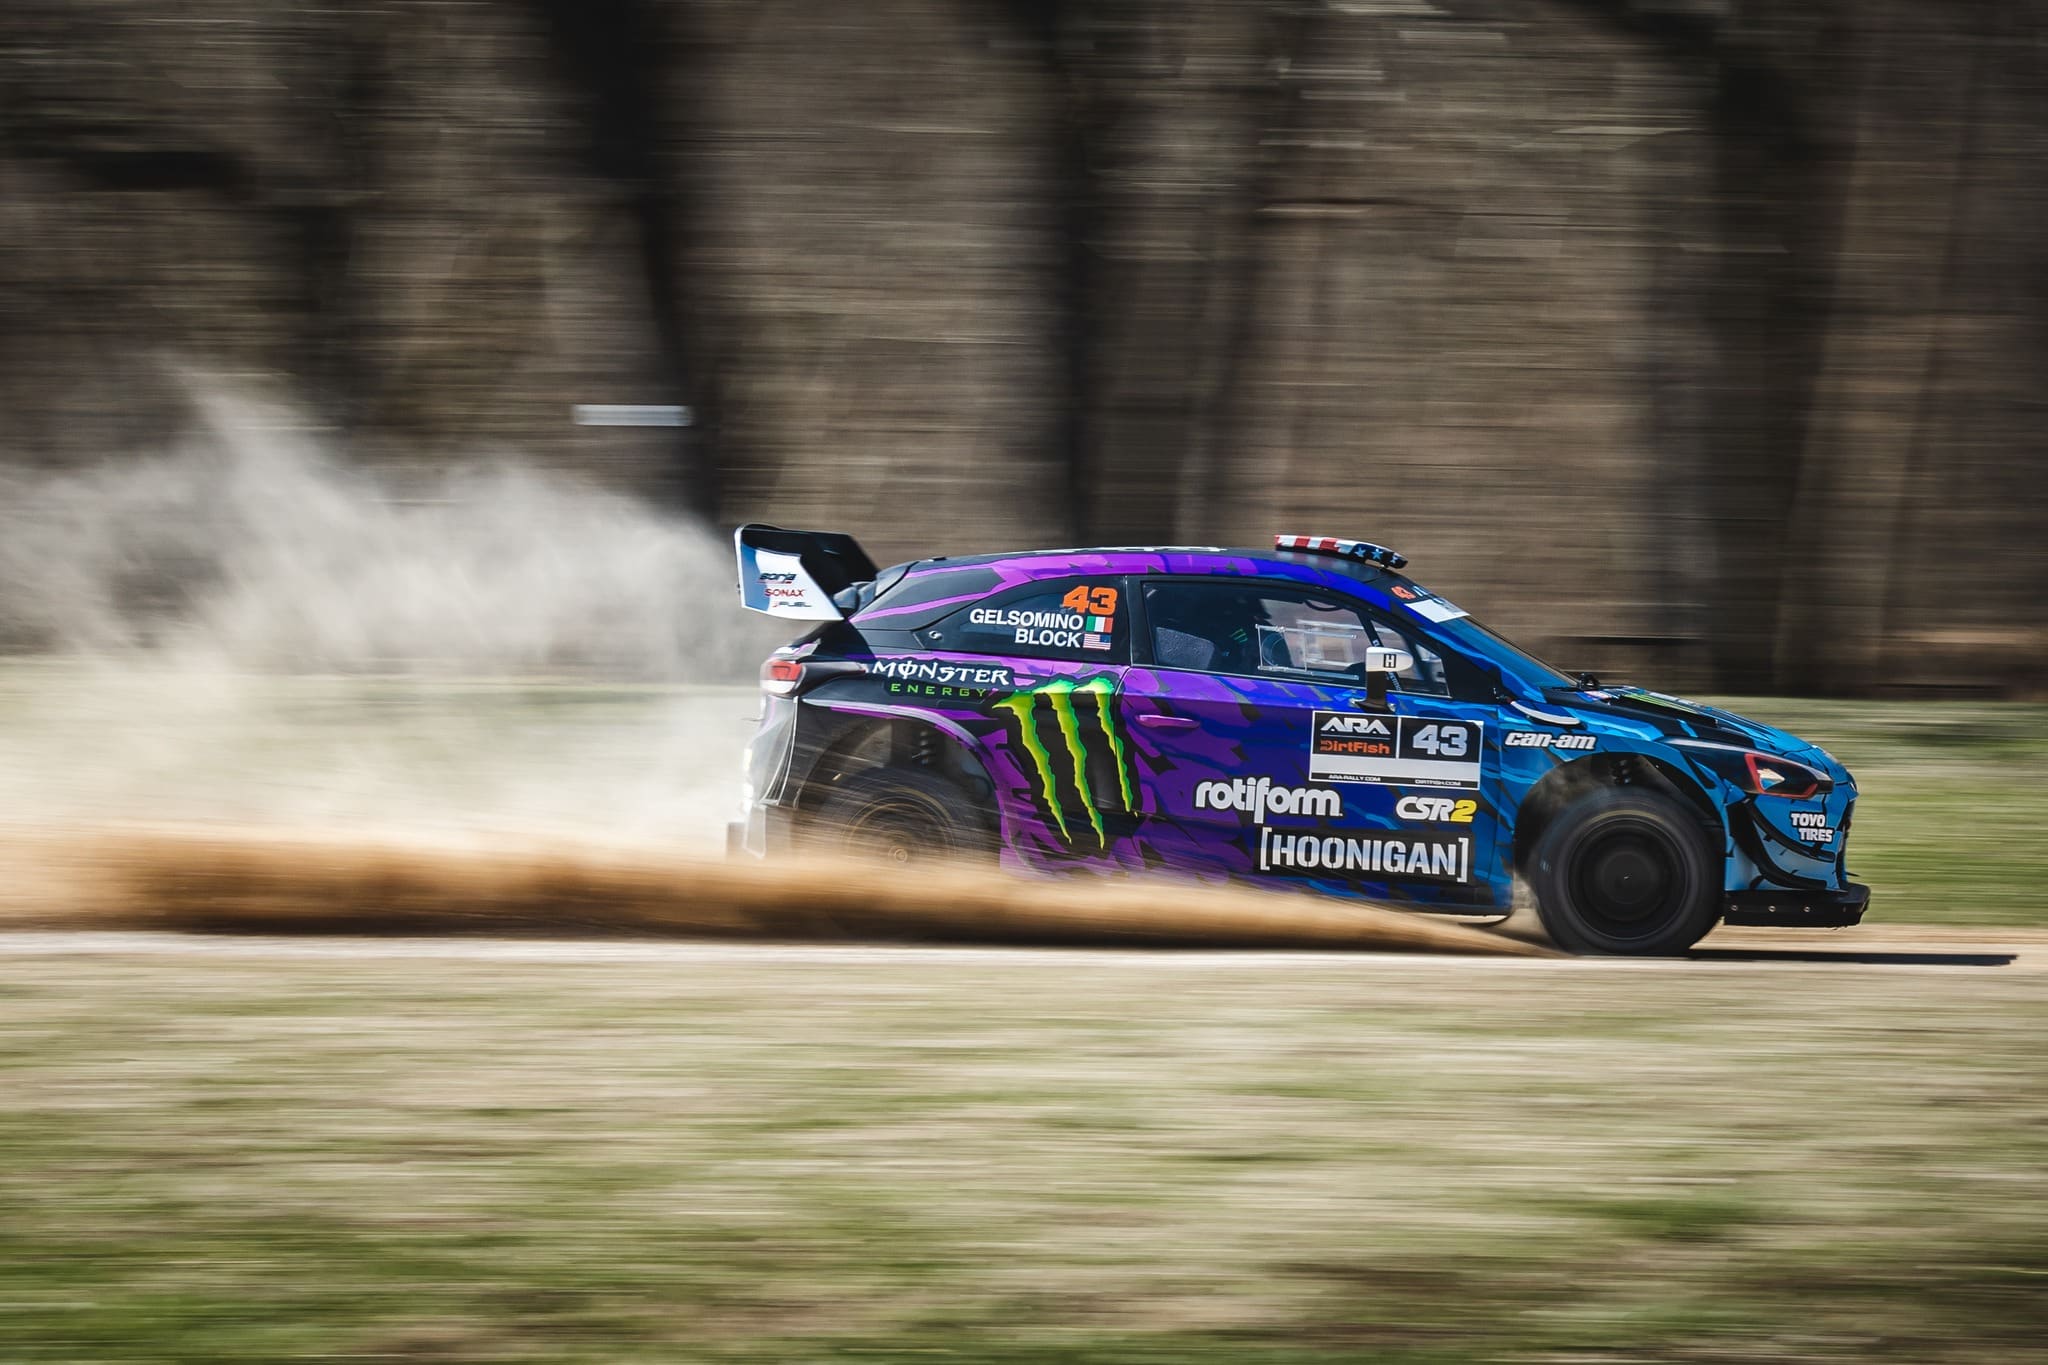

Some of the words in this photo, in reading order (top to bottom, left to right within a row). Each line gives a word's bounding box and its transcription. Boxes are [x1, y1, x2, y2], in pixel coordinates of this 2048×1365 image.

[764, 588, 804, 597] SONAX
[1062, 585, 1118, 616] 43
[970, 608, 1084, 631] GELSOMINO
[1015, 628, 1083, 649] BLOCK
[890, 683, 987, 698] ENERGY
[1320, 717, 1392, 736] ARA
[1319, 739, 1391, 755] DirtFish
[1412, 724, 1468, 757] 43
[1504, 731, 1597, 751] can-am
[1395, 796, 1478, 823] CSR2
[1791, 813, 1826, 827] TOYO
[1799, 828, 1833, 842] TIRES
